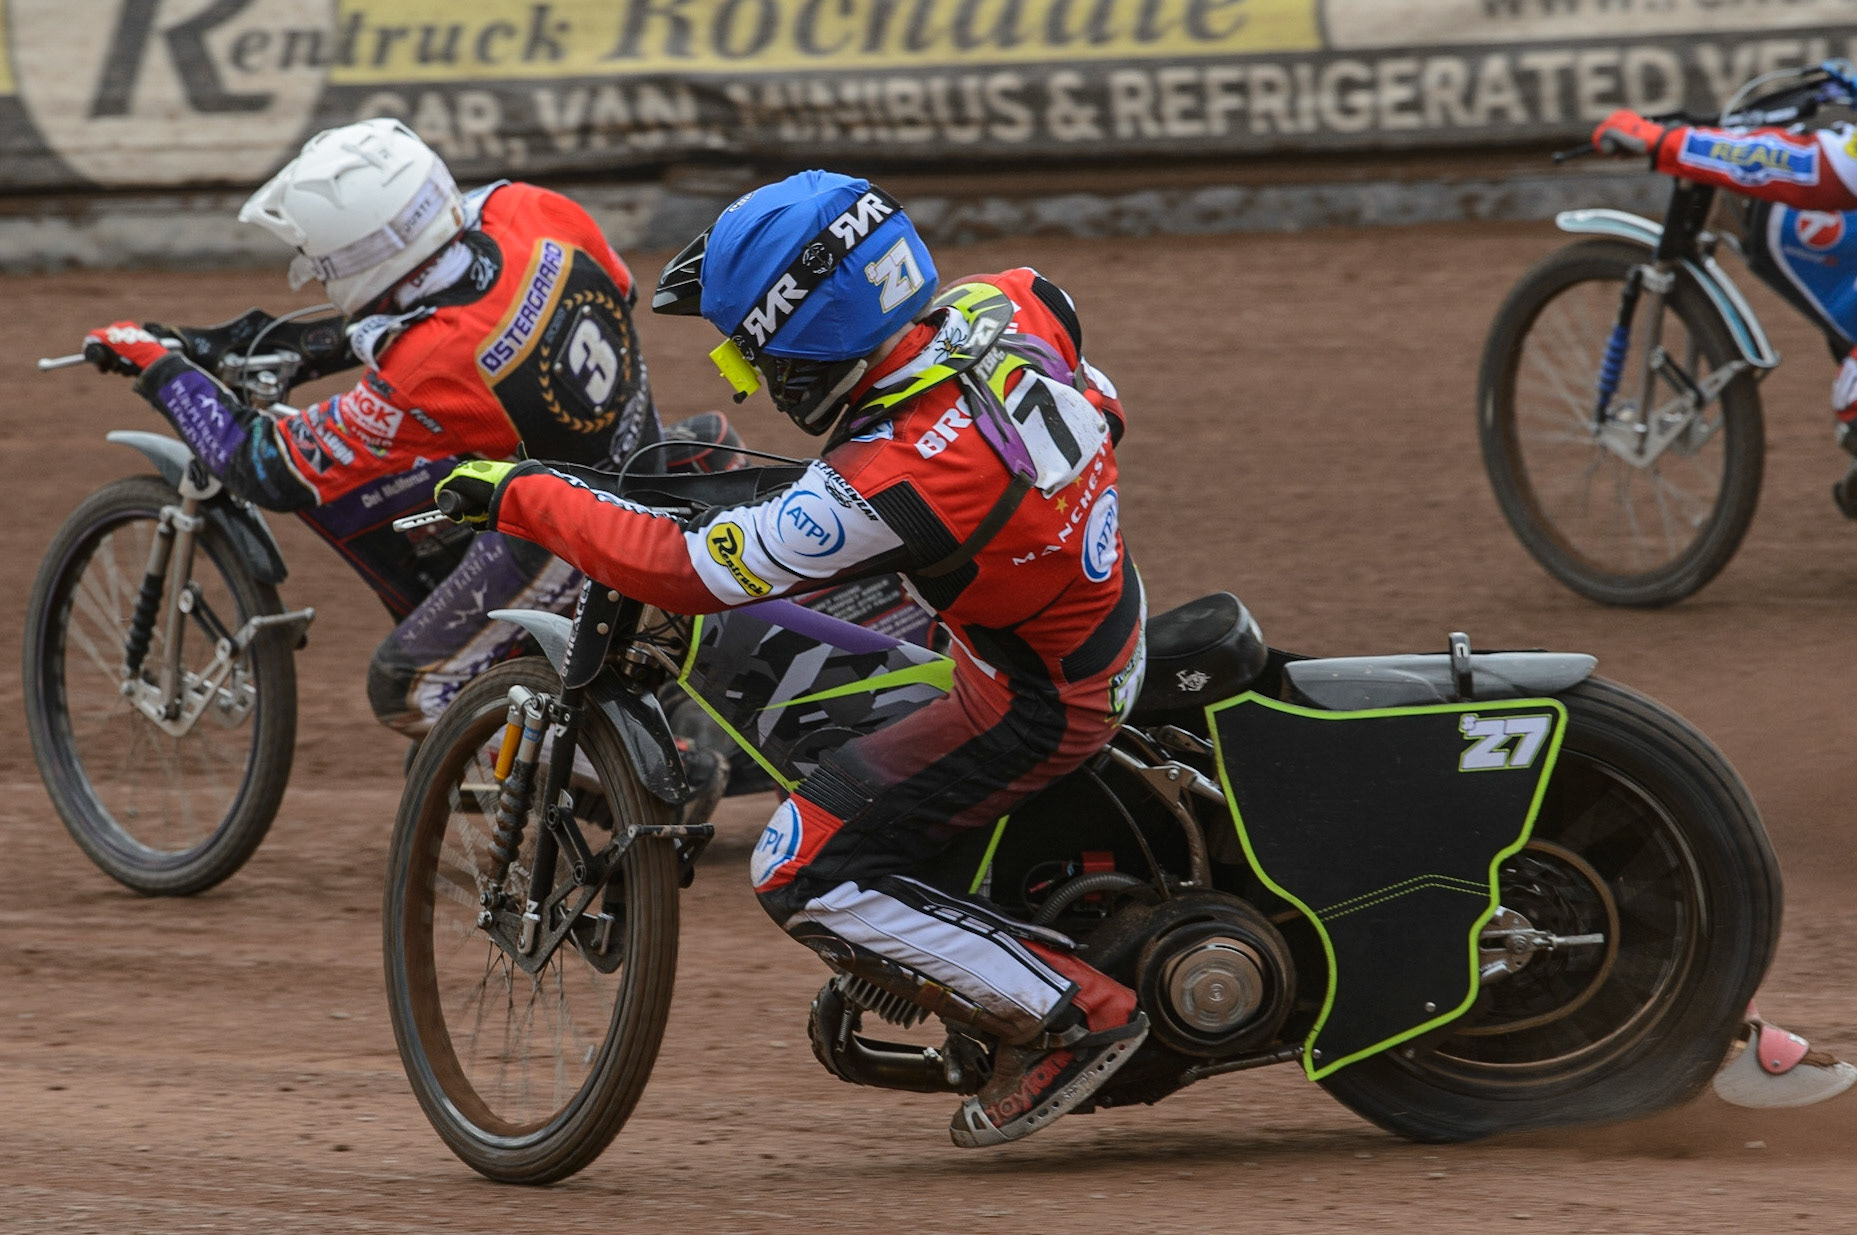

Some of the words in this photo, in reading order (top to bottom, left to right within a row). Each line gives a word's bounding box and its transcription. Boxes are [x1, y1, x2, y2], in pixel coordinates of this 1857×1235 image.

[1046, 70, 1101, 142] &
[1110, 44, 1685, 138] REFRIGERATED
[569, 319, 618, 404] 3
[1012, 378, 1083, 470] 7
[711, 526, 771, 598] Rentruck
[786, 505, 831, 546] ATPI
